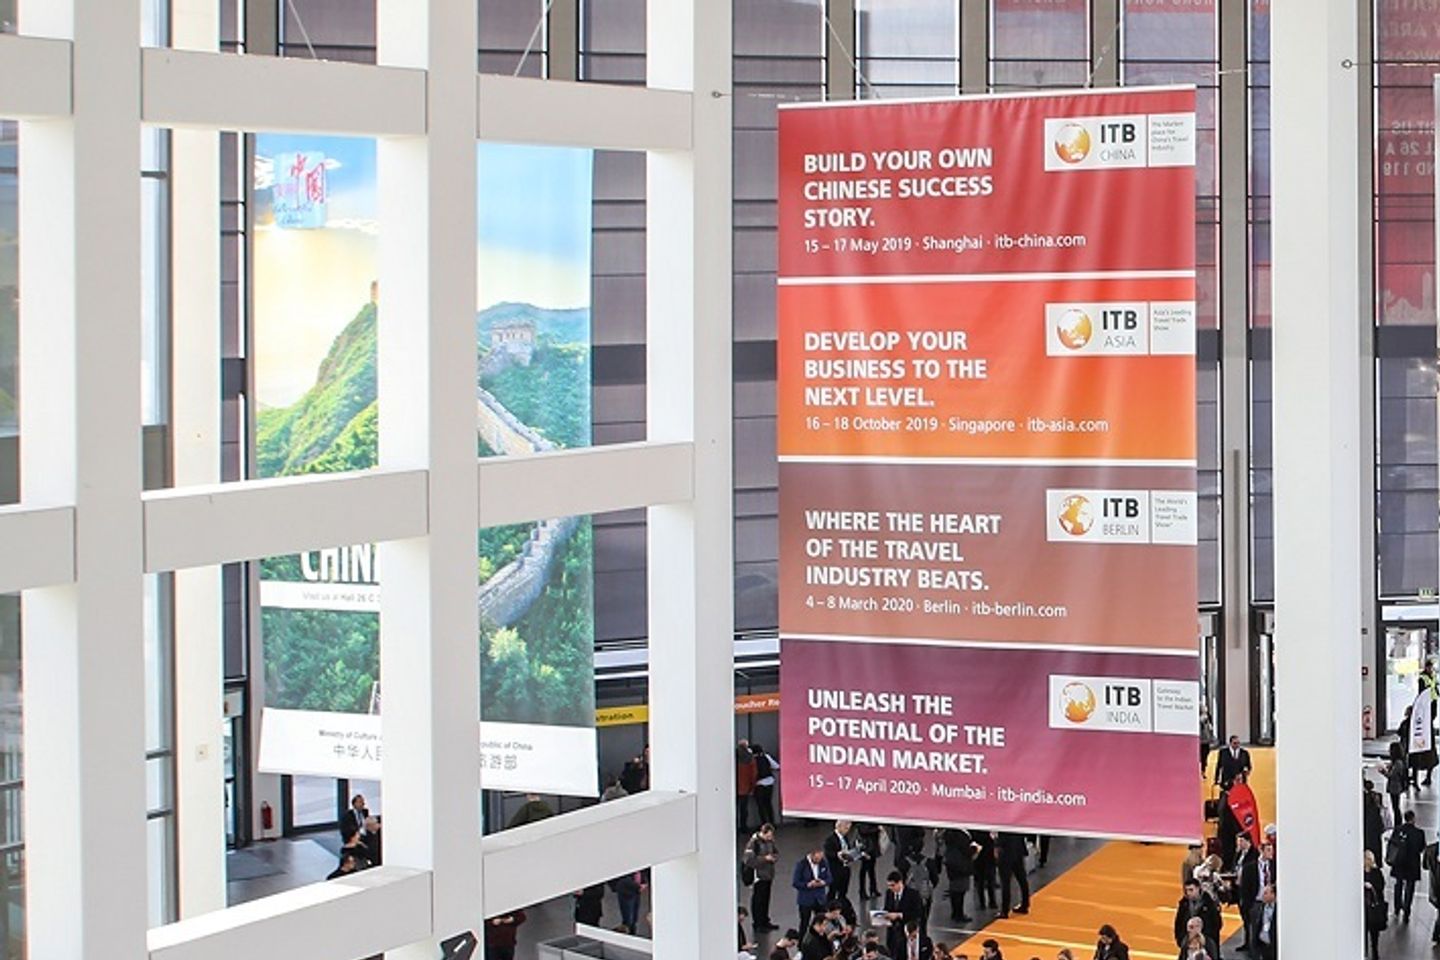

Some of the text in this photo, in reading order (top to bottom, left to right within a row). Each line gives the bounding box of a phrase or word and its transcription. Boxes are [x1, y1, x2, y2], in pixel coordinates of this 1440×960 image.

[1100, 123, 1136, 144] ITB
[803, 148, 993, 174] BUILD YOUR OWN
[1100, 149, 1136, 161] CHINA
[803, 175, 994, 201] CHINESE SUCCESS
[803, 206, 876, 229] STORY.
[804, 233, 1087, 254] 15 17 May 2019 Shanghai itb-china.com
[1103, 310, 1138, 330] ITB
[804, 330, 969, 352] DEVELOP YOUR
[1103, 335, 1137, 348] ASIA
[804, 358, 988, 380] BUSINESS TO THE
[804, 386, 936, 408] NEXT LEVEL.
[805, 416, 1109, 435] 16 18 October 2019 Singapore itb-asia.com
[1103, 498, 1139, 518] ITB
[804, 510, 1002, 534] WHERE THE HEART
[1103, 524, 1139, 536] BERLIN
[805, 538, 965, 562] OF THE TRAVEL
[300, 544, 381, 583] CHIN
[806, 565, 990, 591] INDUSTRY BEATS.
[805, 595, 1068, 617] 4 8 March 2020 Berlin itb-berlin.com
[808, 688, 906, 714] UNLEASH
[911, 694, 954, 717] THE
[1105, 685, 1142, 706] ITB
[1107, 711, 1141, 724] INDIA
[808, 716, 1005, 747] POTENTIAL OF THE
[808, 743, 989, 775] INDIAN MARKET.
[808, 774, 1087, 806] 15 17 April 2020 Mumbai itb-india.com
